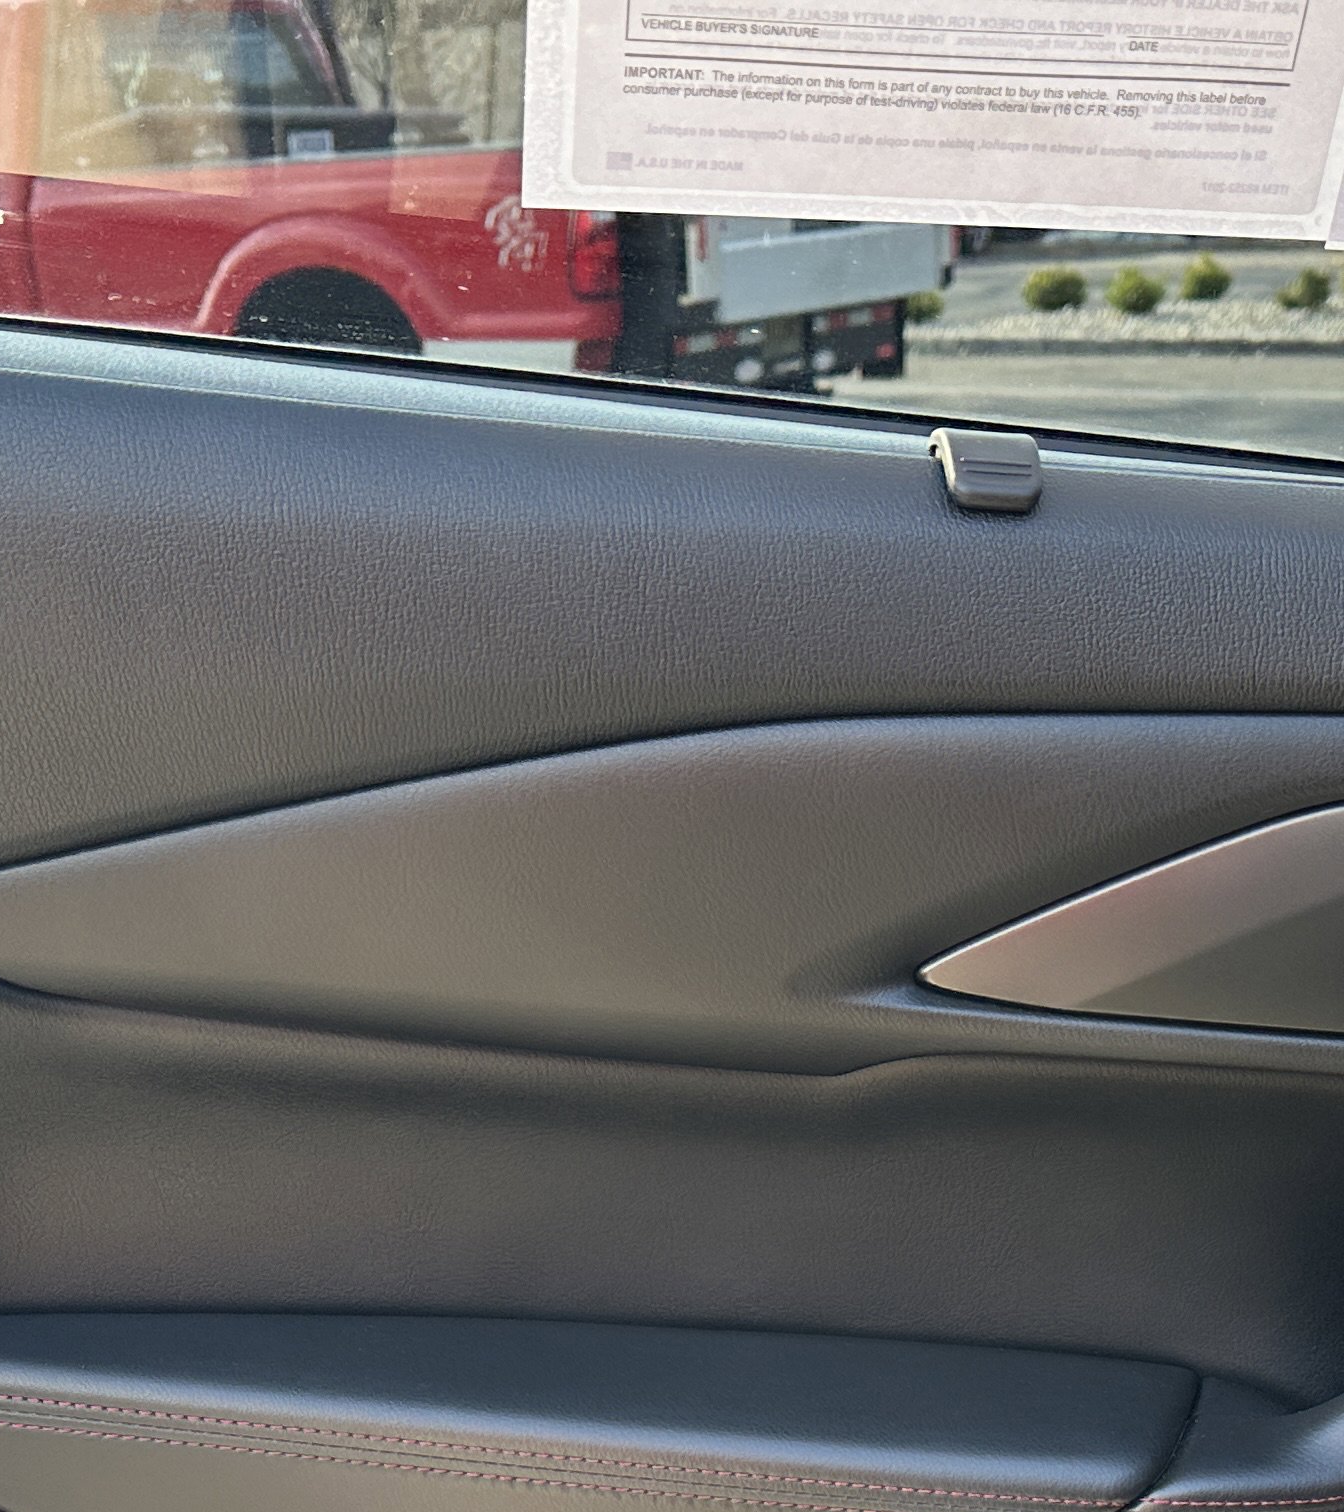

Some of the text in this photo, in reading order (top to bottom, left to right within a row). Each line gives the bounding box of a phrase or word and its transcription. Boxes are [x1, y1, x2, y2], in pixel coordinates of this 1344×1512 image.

[641, 18, 692, 31] VEHICLE
[695, 20, 747, 34] BUYER'S
[750, 24, 819, 38] SIGNATURE
[1128, 40, 1158, 52] DATE
[624, 66, 1266, 106] IMPORTANT: The information on this form is part of any contract to buy this vehicle. Removing this label before
[623, 84, 680, 96] consumer
[684, 87, 738, 98] purchase
[741, 88, 783, 102] (except
[786, 91, 802, 101] for
[805, 94, 852, 105] purpose
[856, 95, 869, 106] of
[870, 95, 938, 111] test-driving)
[941, 99, 985, 111] violates
[988, 100, 1027, 113] federal
[1031, 102, 1051, 114] law
[1053, 103, 1071, 117] (16
